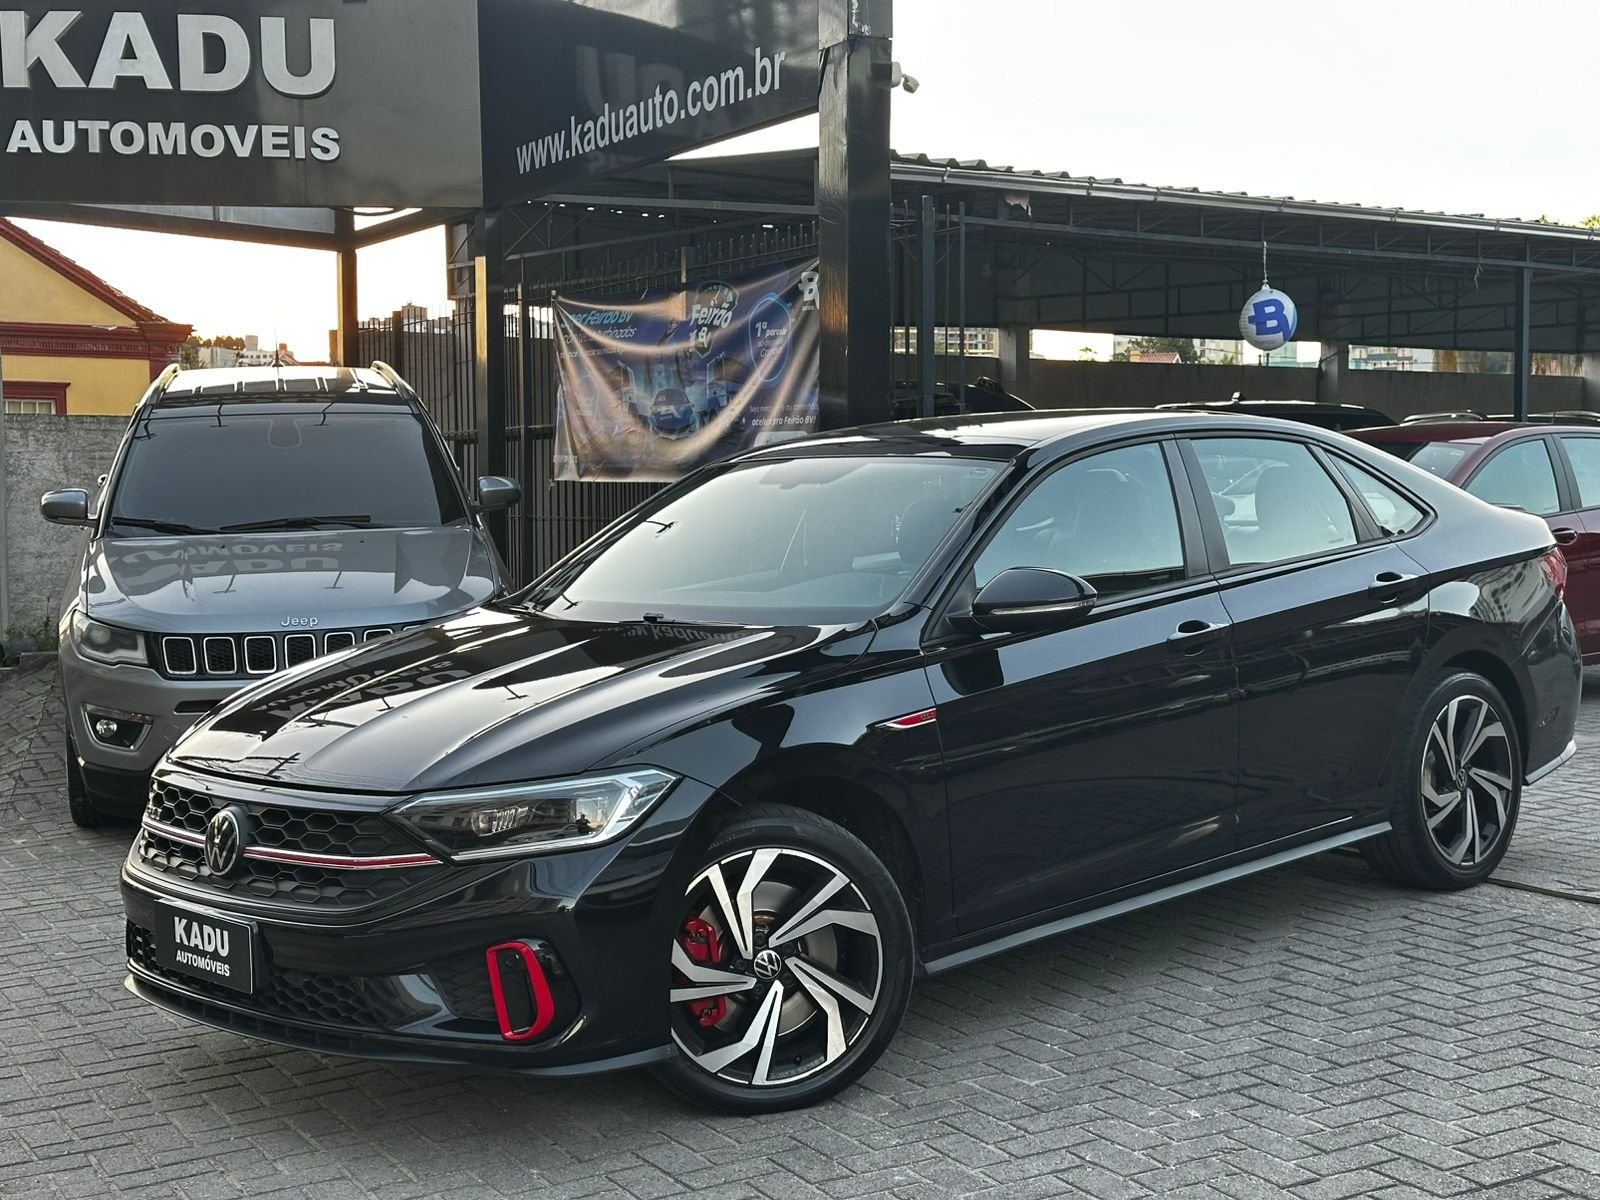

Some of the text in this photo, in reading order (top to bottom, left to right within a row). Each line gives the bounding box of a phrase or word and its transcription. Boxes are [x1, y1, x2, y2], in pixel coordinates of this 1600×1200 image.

[0, 11, 337, 97] KADU
[516, 47, 785, 174] www.kaduauto.com.br
[6, 119, 341, 161] AUTOMOVEIS
[280, 615, 319, 628] Jeep
[173, 916, 230, 957] KADU
[175, 949, 231, 977] AUTOMÓVEIS
